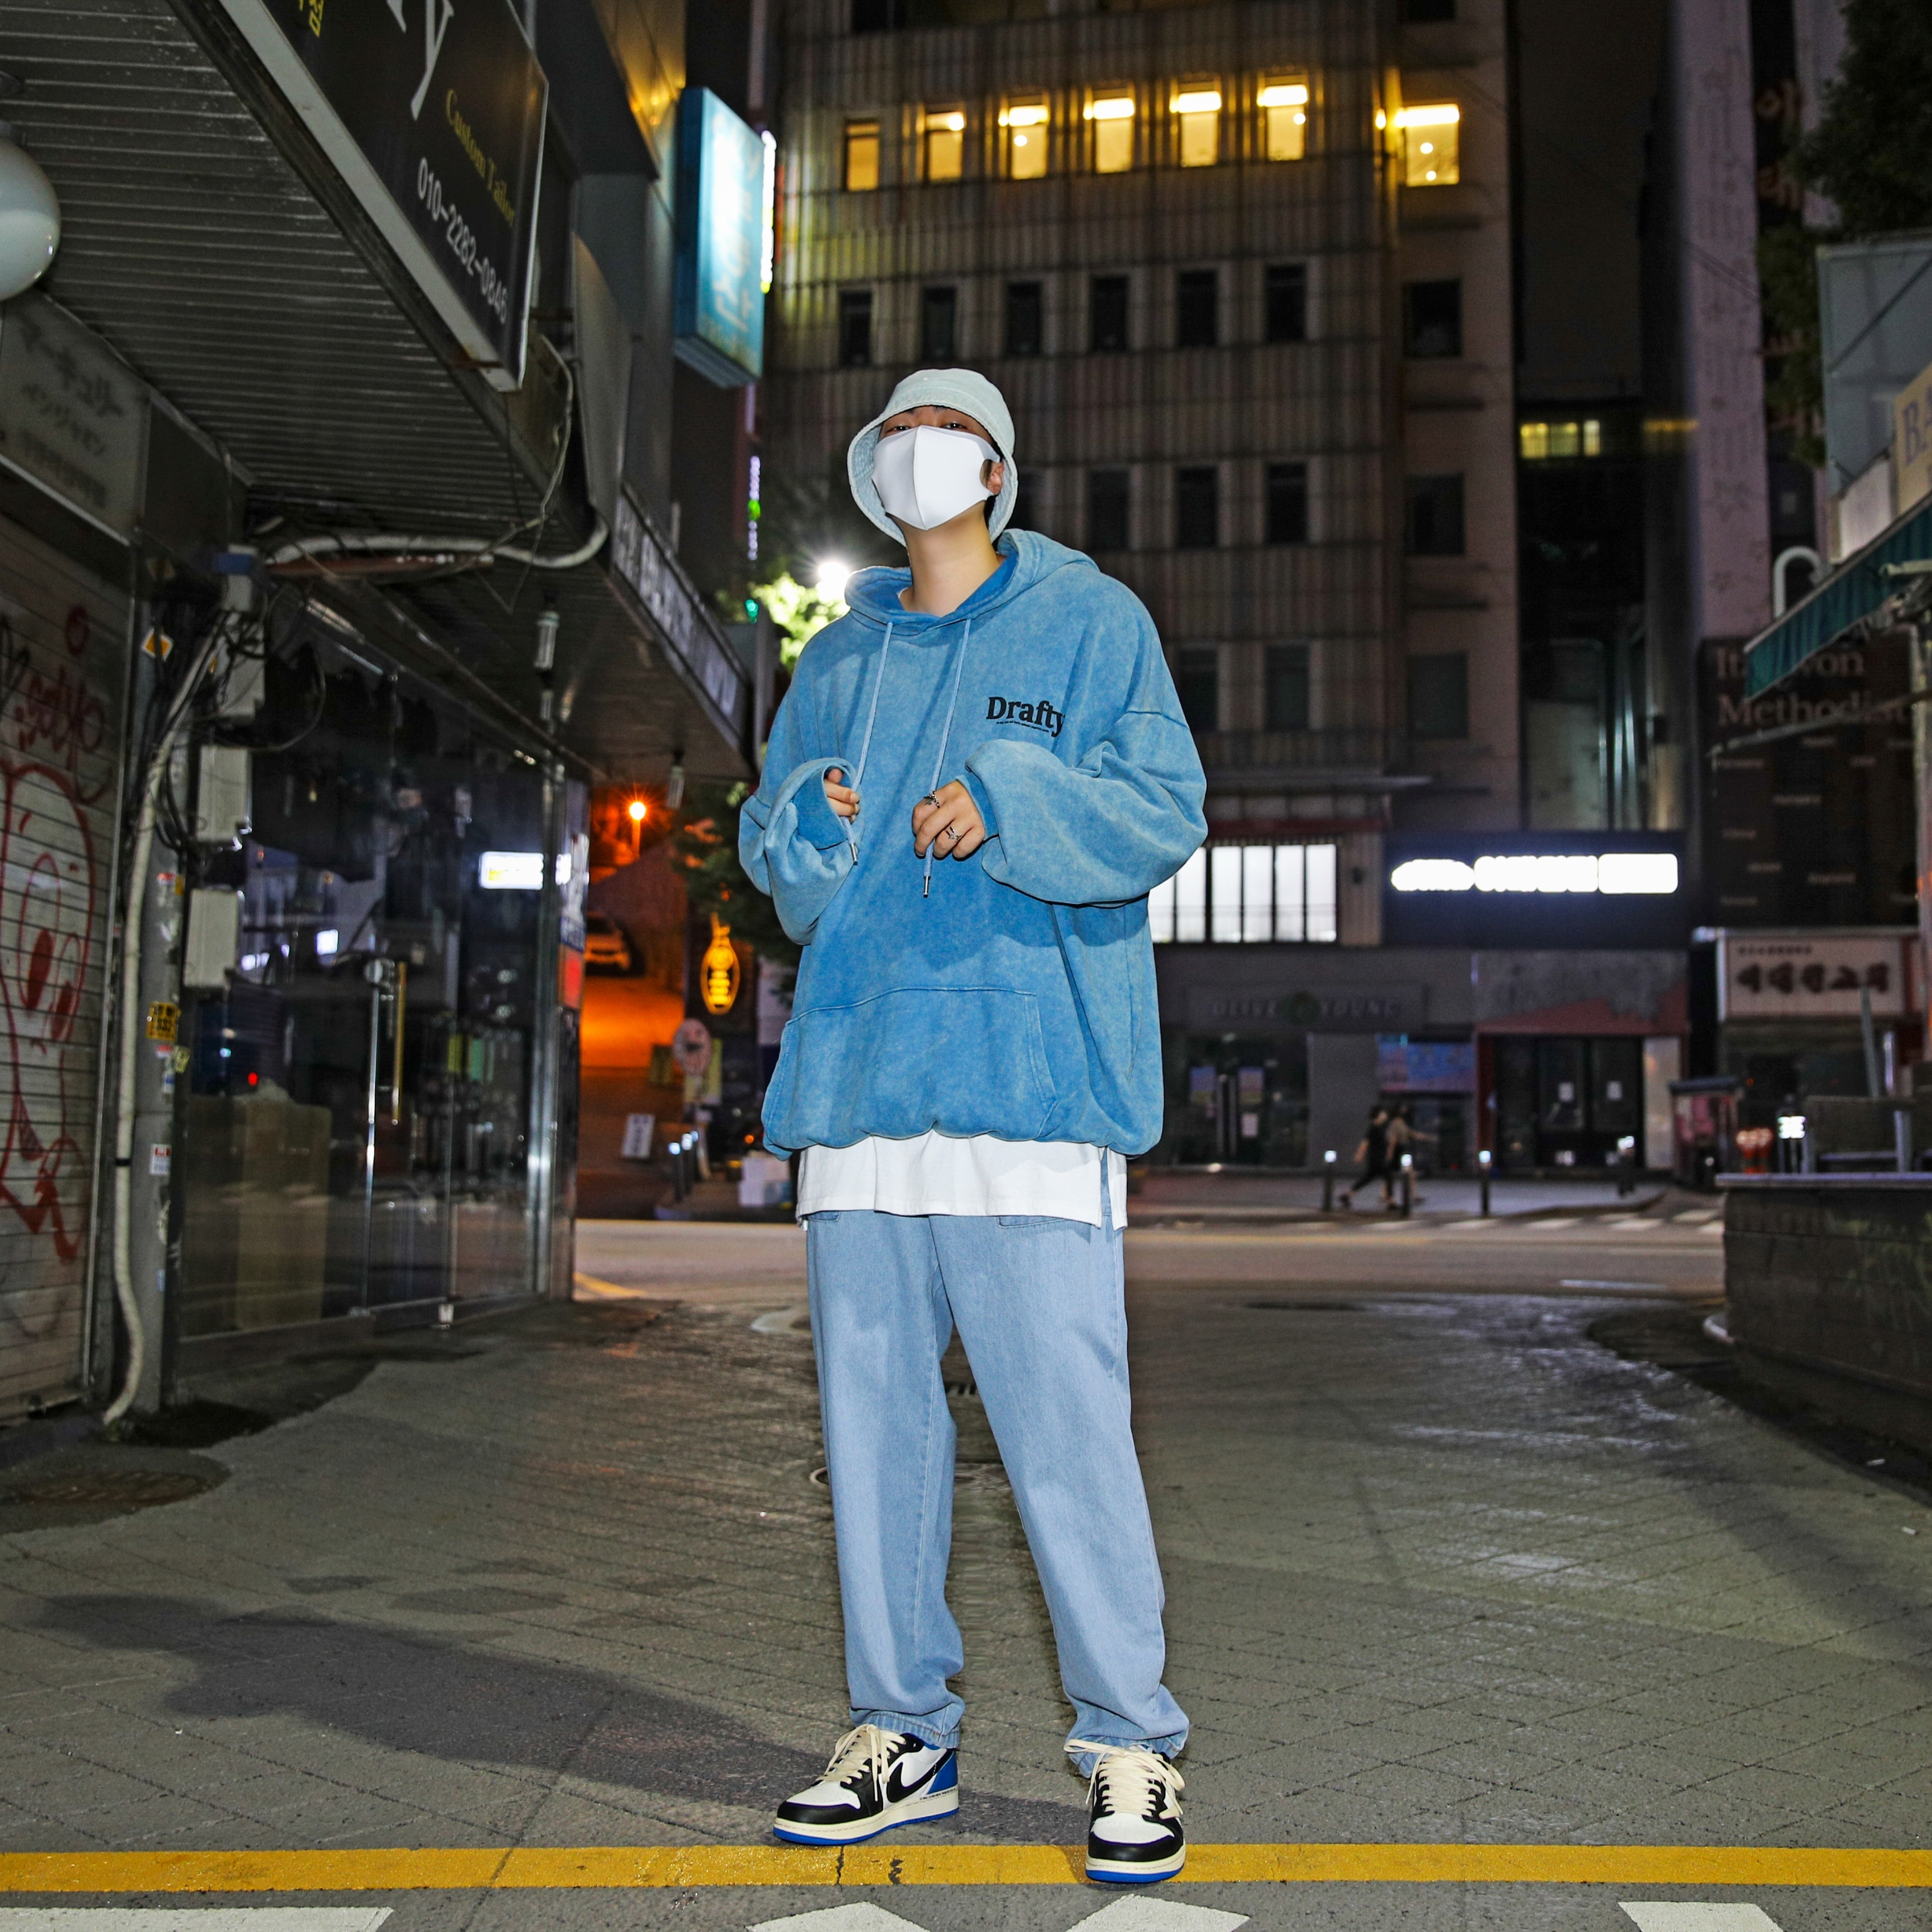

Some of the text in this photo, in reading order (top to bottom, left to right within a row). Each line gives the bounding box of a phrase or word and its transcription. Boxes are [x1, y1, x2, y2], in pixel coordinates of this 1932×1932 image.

[446, 89, 515, 228] Custom Tailor
[1715, 646, 1865, 679] Iton
[986, 696, 1066, 738] Drafty
